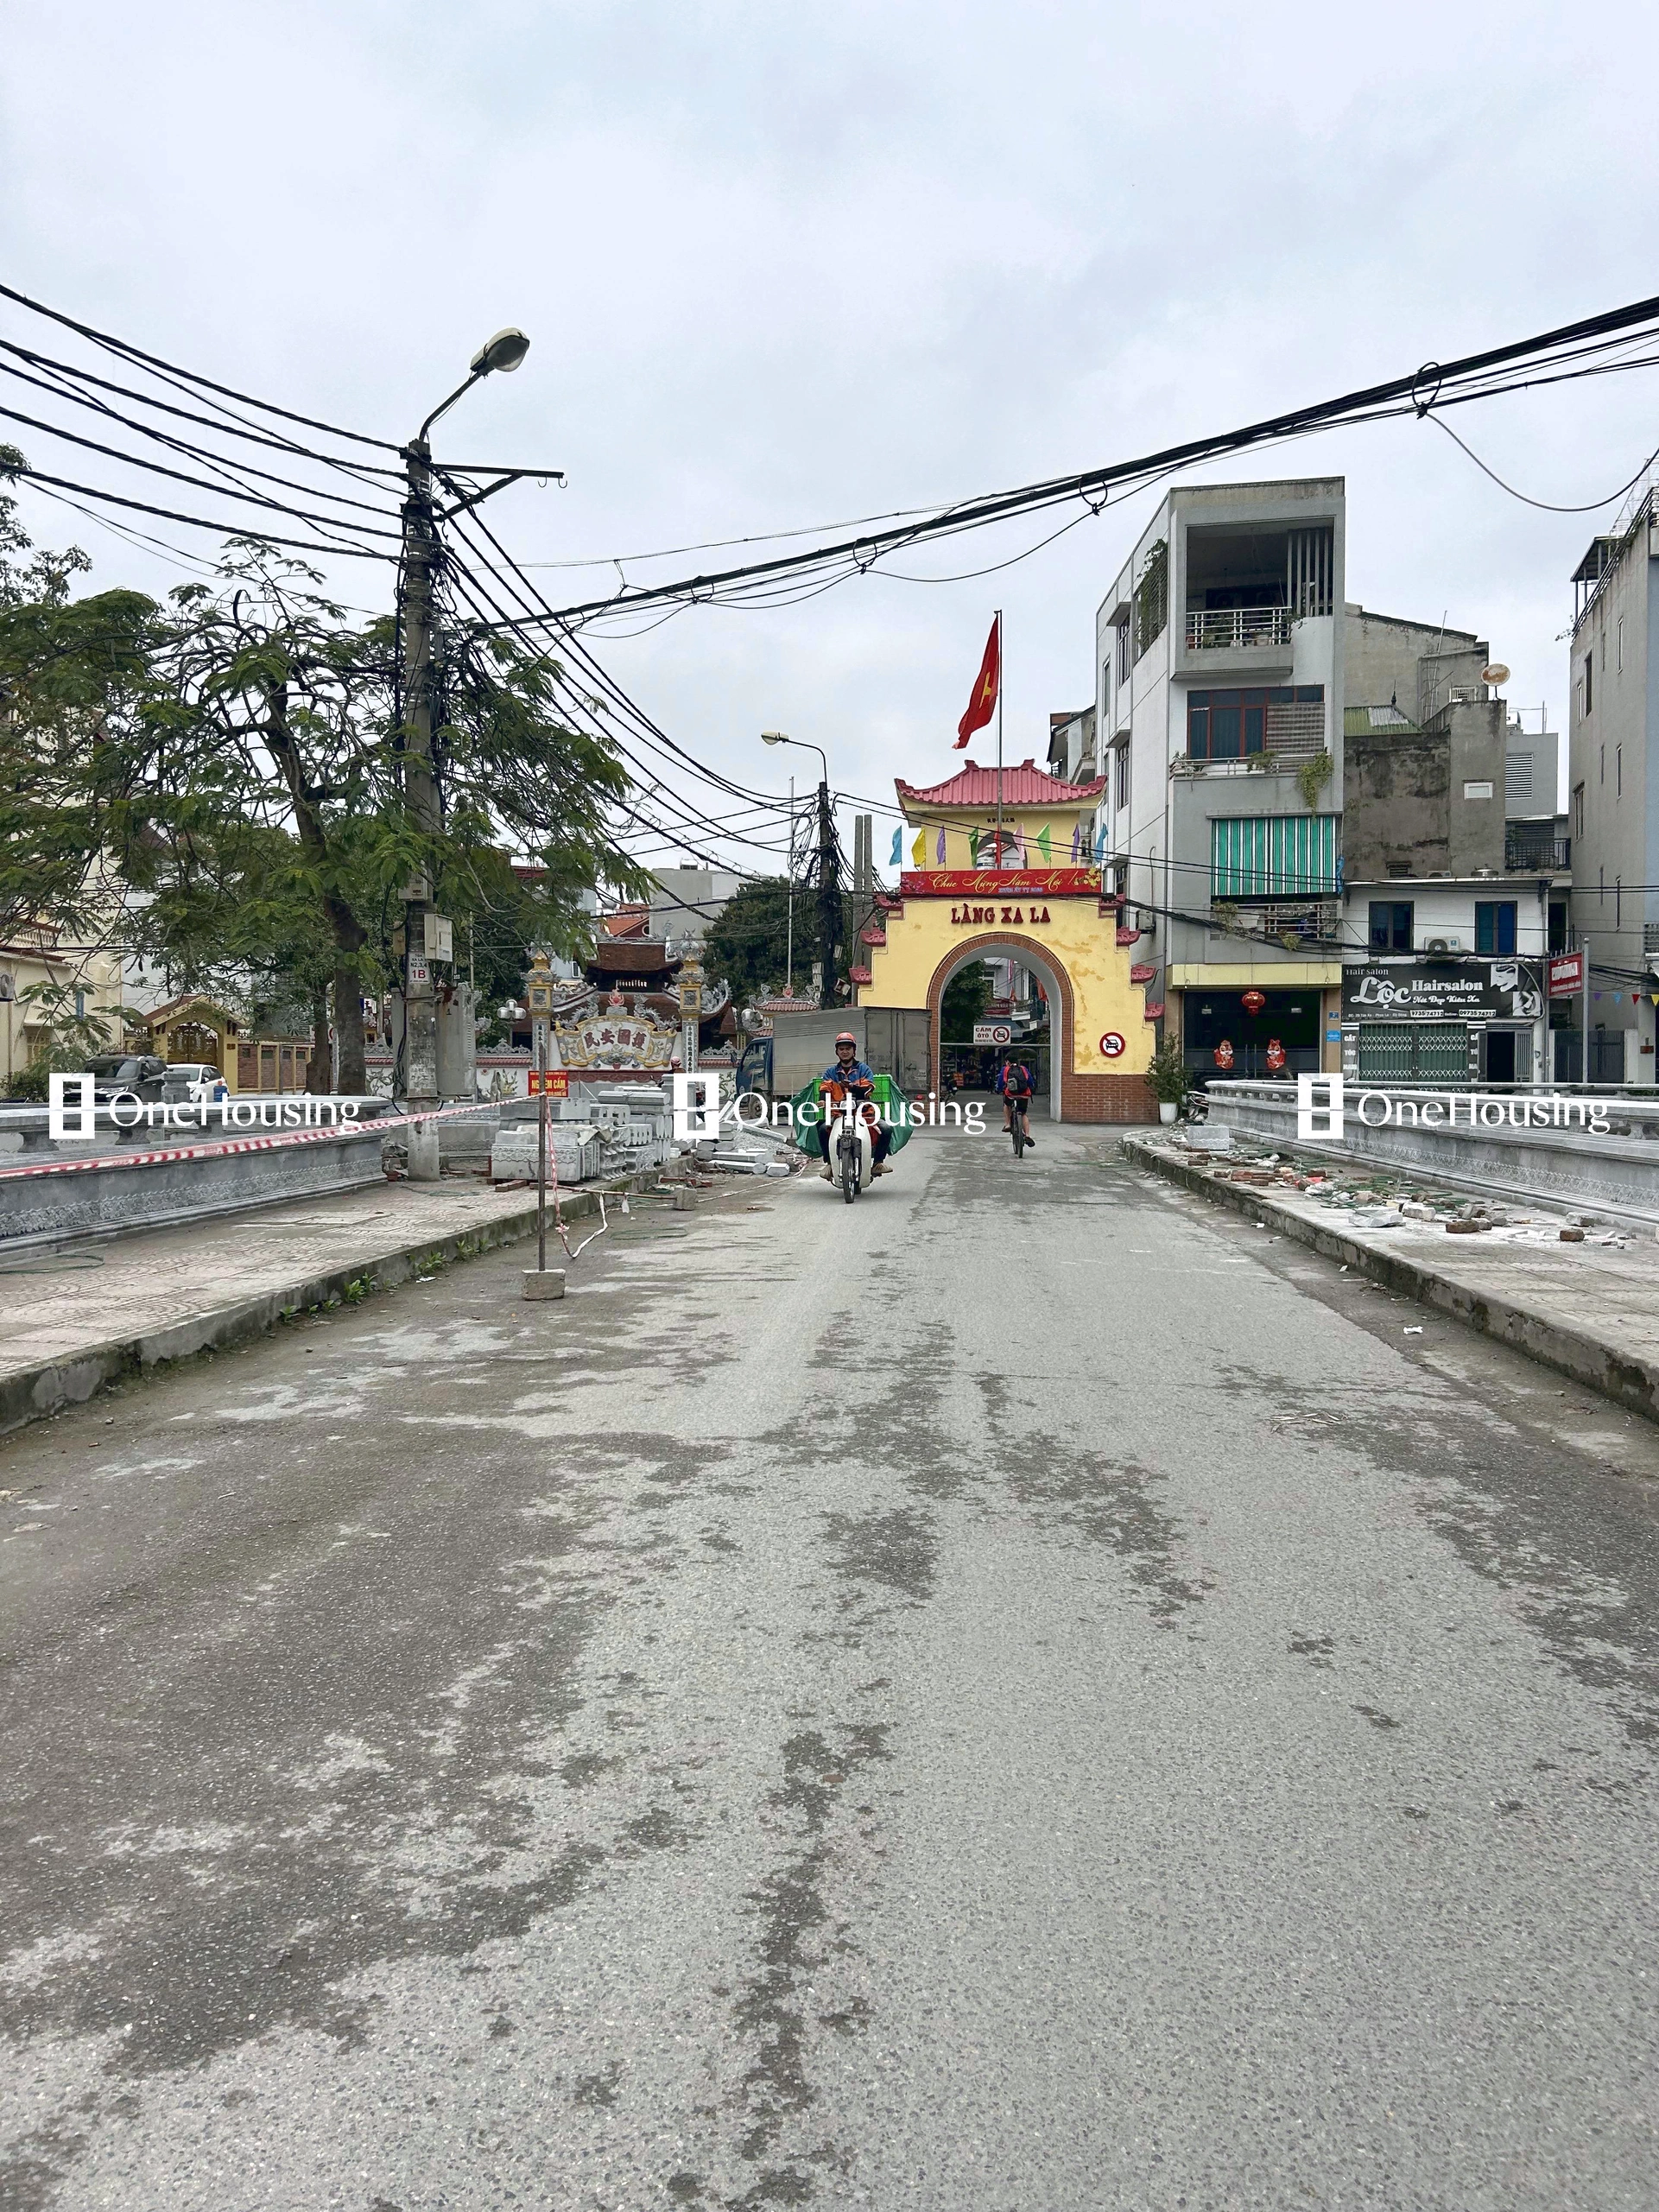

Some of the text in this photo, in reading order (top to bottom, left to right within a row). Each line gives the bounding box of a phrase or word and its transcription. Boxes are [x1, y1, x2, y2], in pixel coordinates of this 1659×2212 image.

[951, 903, 1051, 923] LÀNG XA LA
[412, 970, 426, 979] 1B
[1350, 976, 1411, 1009] Lộc
[1411, 979, 1483, 992] Hairsalon
